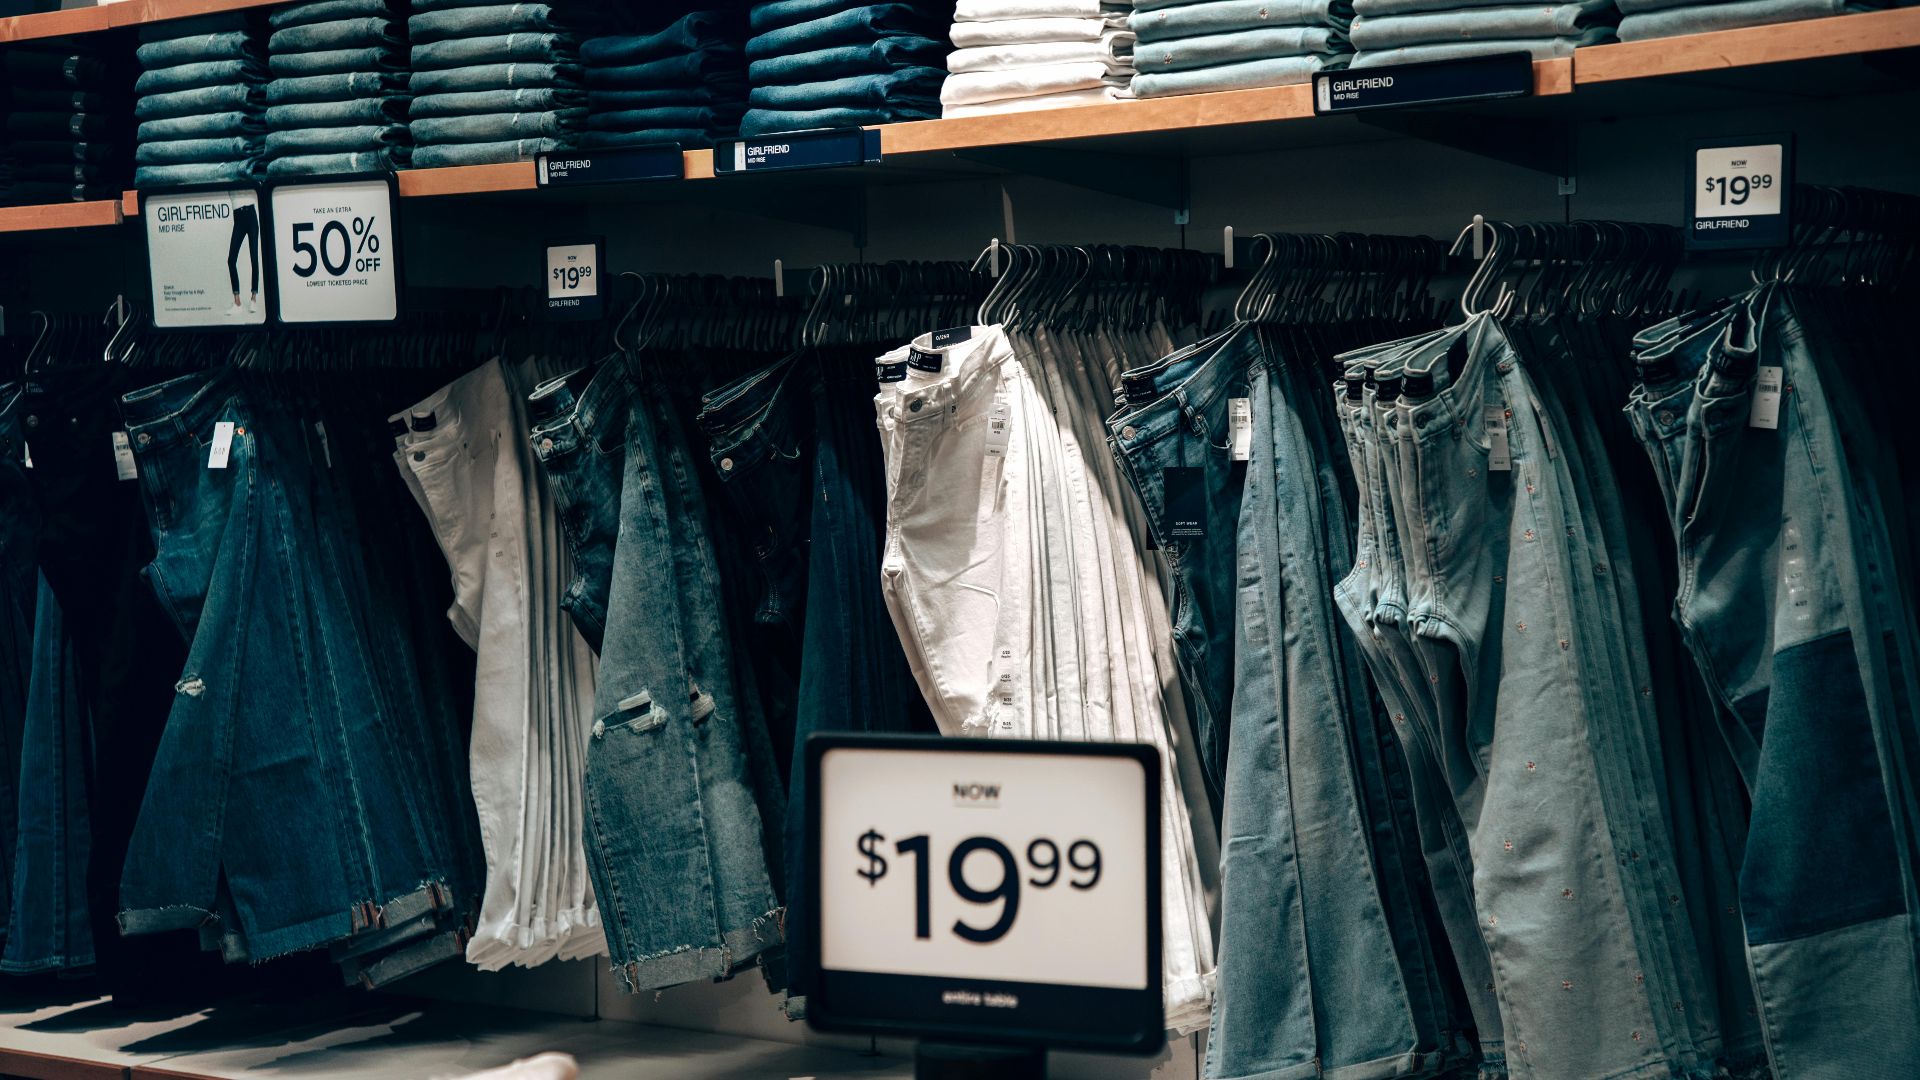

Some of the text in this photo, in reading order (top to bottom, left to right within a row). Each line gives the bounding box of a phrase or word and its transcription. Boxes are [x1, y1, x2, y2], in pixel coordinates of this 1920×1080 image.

[1333, 76, 1394, 92] GIRLFRIEND
[747, 144, 790, 156] GIRLFRIEND
[549, 160, 591, 170] GIRLFRIEND
[157, 203, 230, 222] GIRLFRIEND
[158, 224, 185, 233] MID RISE
[1695, 219, 1750, 230] GIRLFRIEND
[292, 216, 380, 278] 50%
[355, 258, 381, 273] OFF
[548, 299, 580, 307] GIRLFRIEND
[953, 783, 1001, 801] NOW
[942, 990, 1018, 1008] entire table
